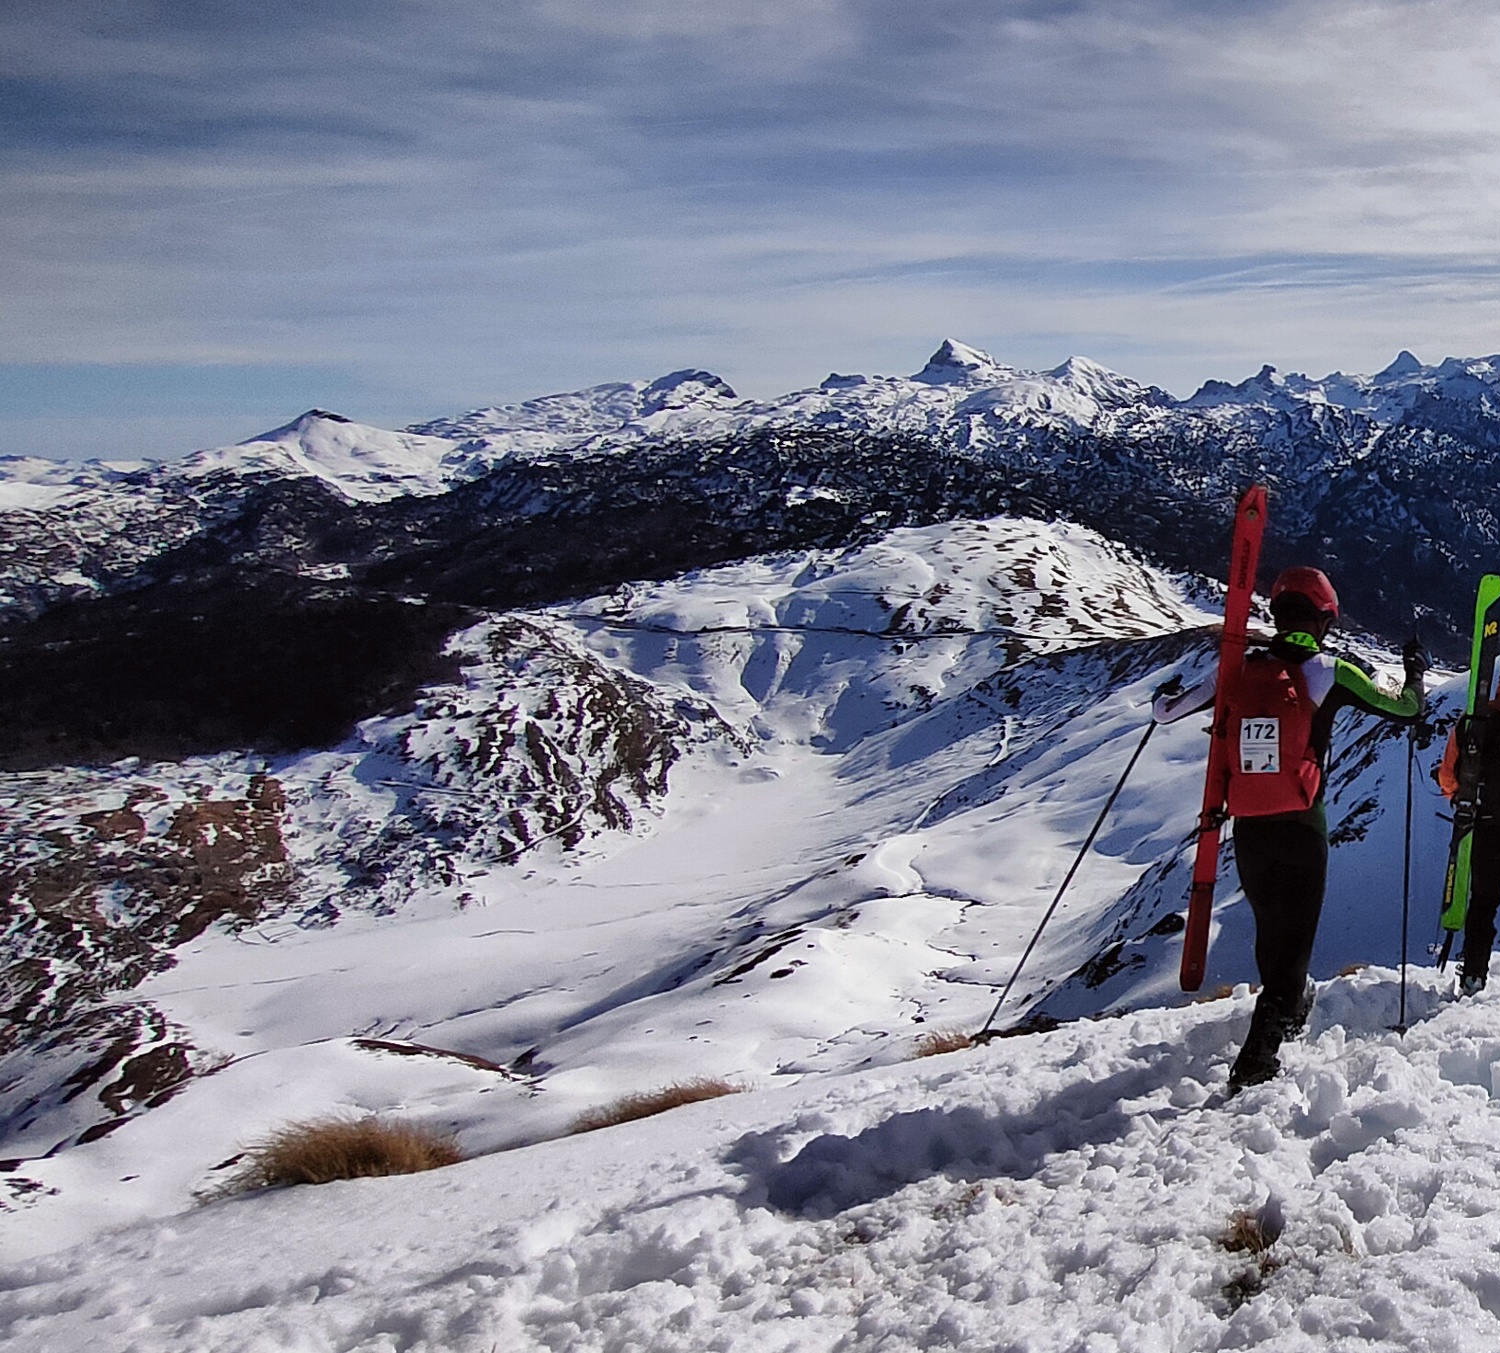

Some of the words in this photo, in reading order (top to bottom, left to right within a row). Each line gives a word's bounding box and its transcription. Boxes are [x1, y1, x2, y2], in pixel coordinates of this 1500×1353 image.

[1237, 537, 1251, 590] ATOMIC
[1484, 621, 1498, 638] K2
[1244, 723, 1276, 739] 172
